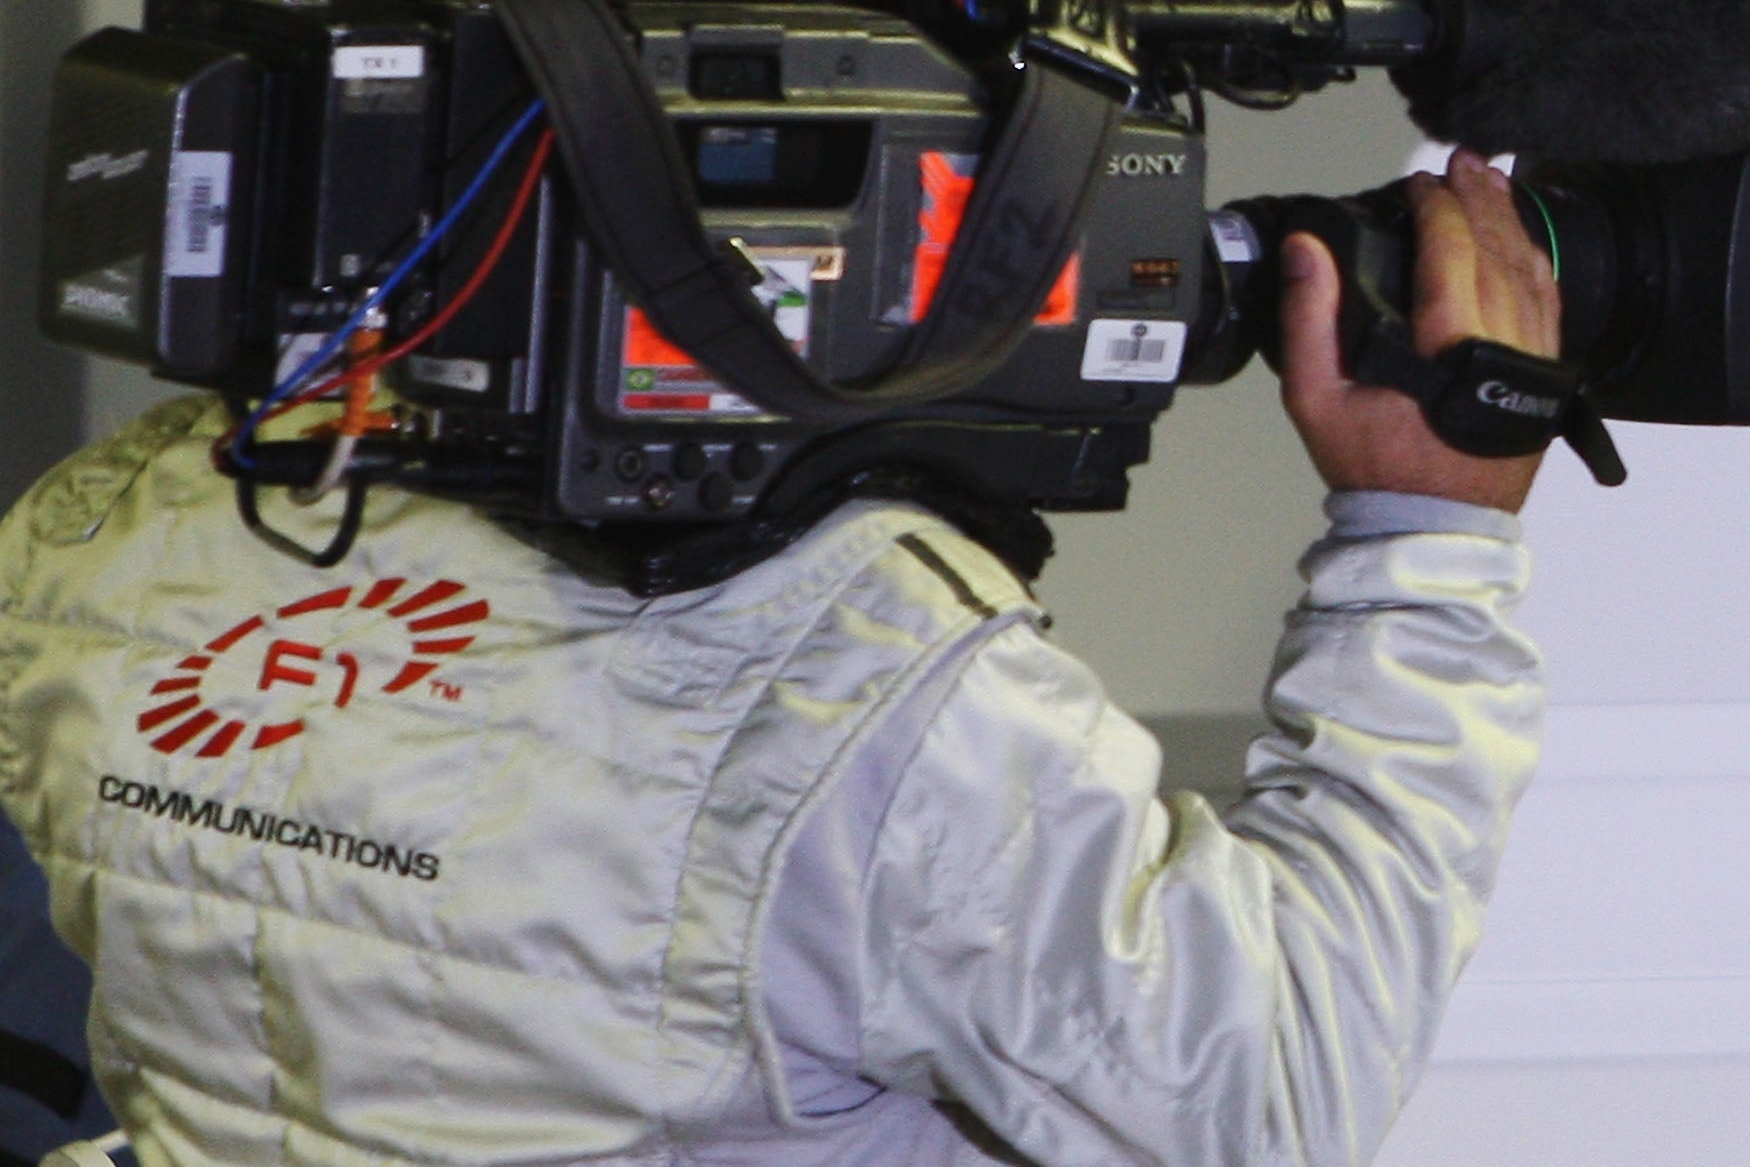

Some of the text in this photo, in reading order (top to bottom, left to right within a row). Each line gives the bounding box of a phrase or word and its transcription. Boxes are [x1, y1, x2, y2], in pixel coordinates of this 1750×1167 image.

[1476, 380, 1560, 419] Canon
[259, 639, 359, 709] F1
[98, 774, 440, 881] COMMUNICATIONS
